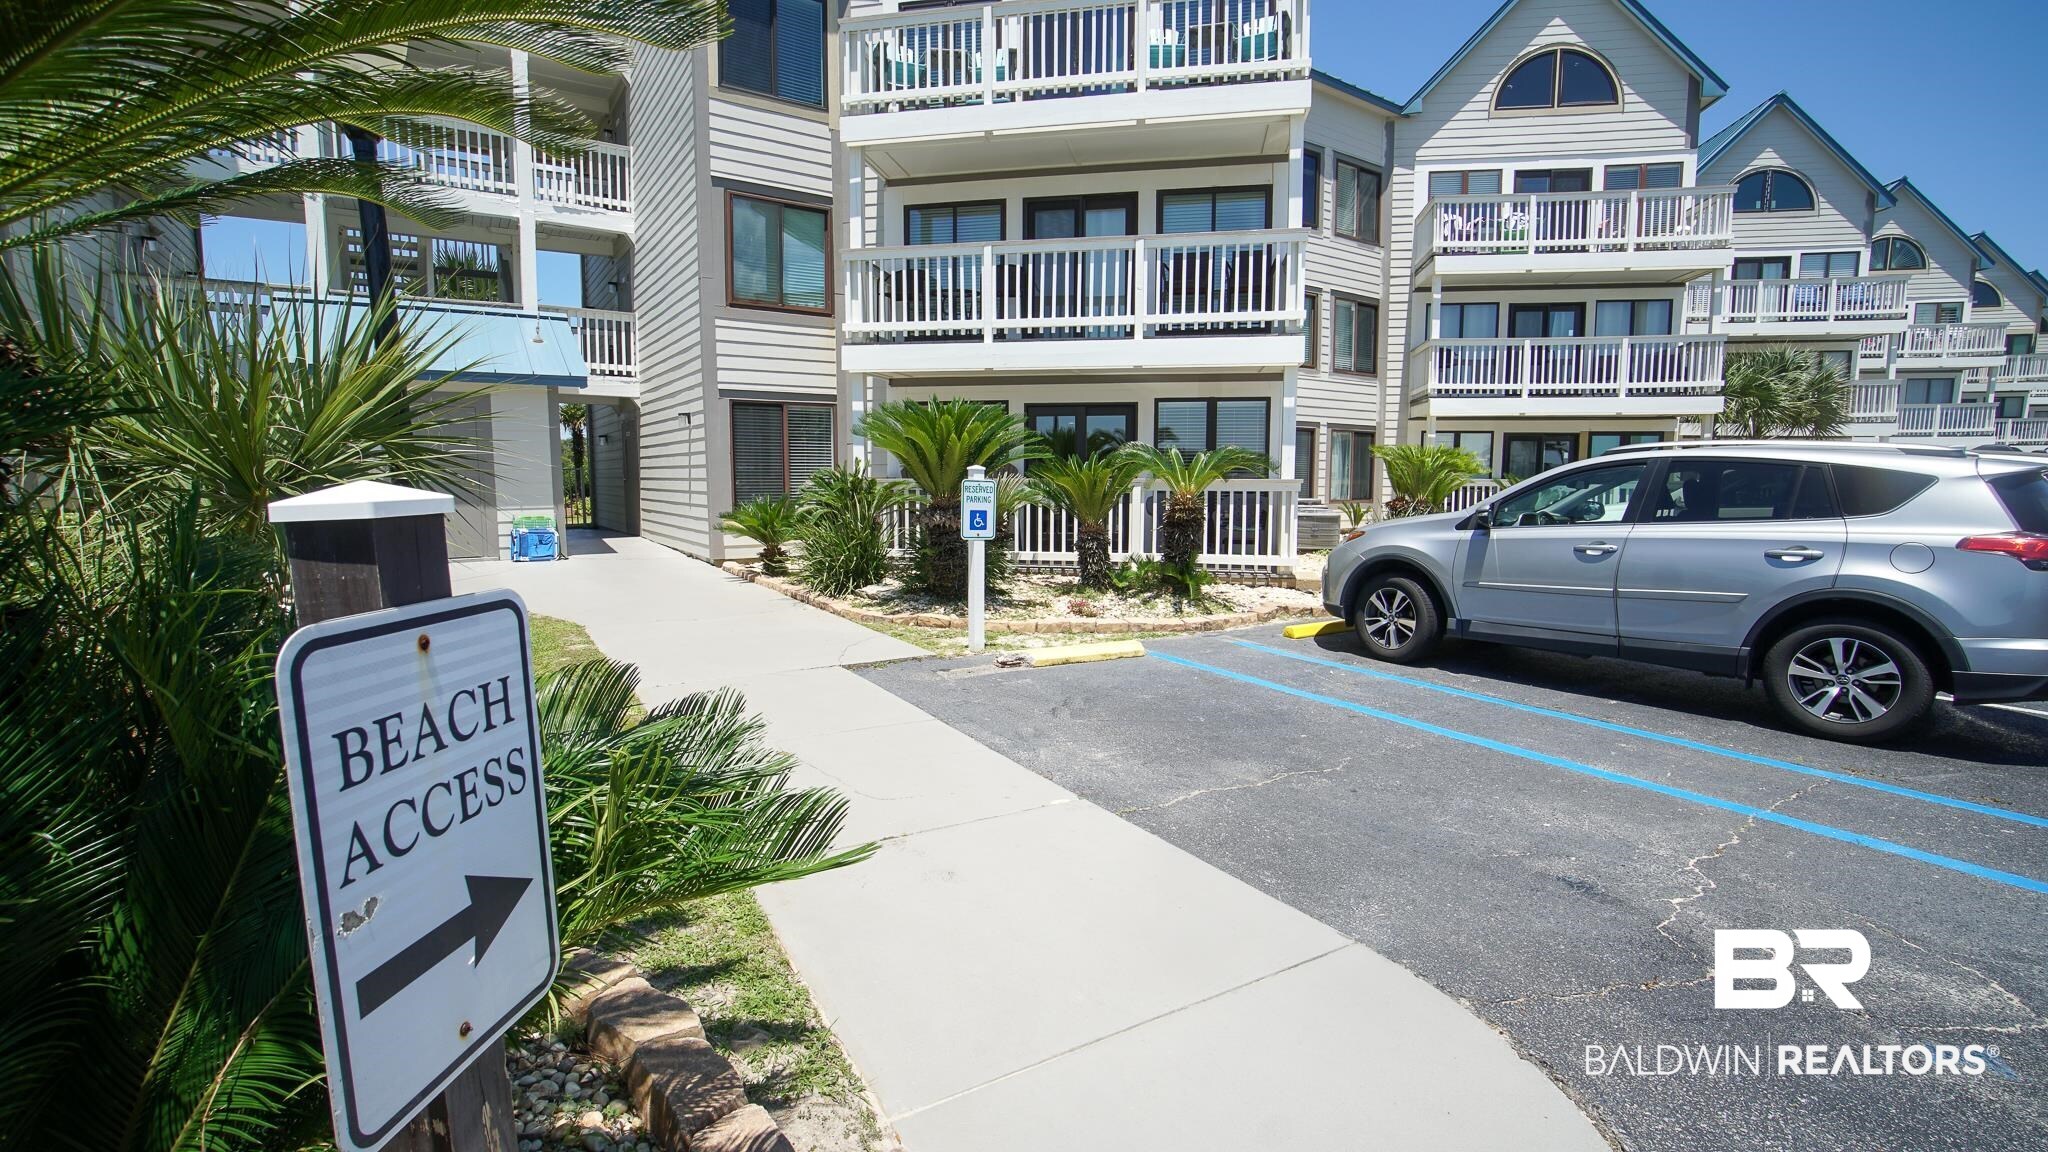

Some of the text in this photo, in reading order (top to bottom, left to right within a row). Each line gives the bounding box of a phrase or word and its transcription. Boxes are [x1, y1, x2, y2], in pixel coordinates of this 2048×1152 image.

[965, 485, 994, 494] RESERVED
[966, 495, 992, 504] PARKING
[331, 676, 516, 793] BEACH
[339, 746, 527, 889] ACCESS
